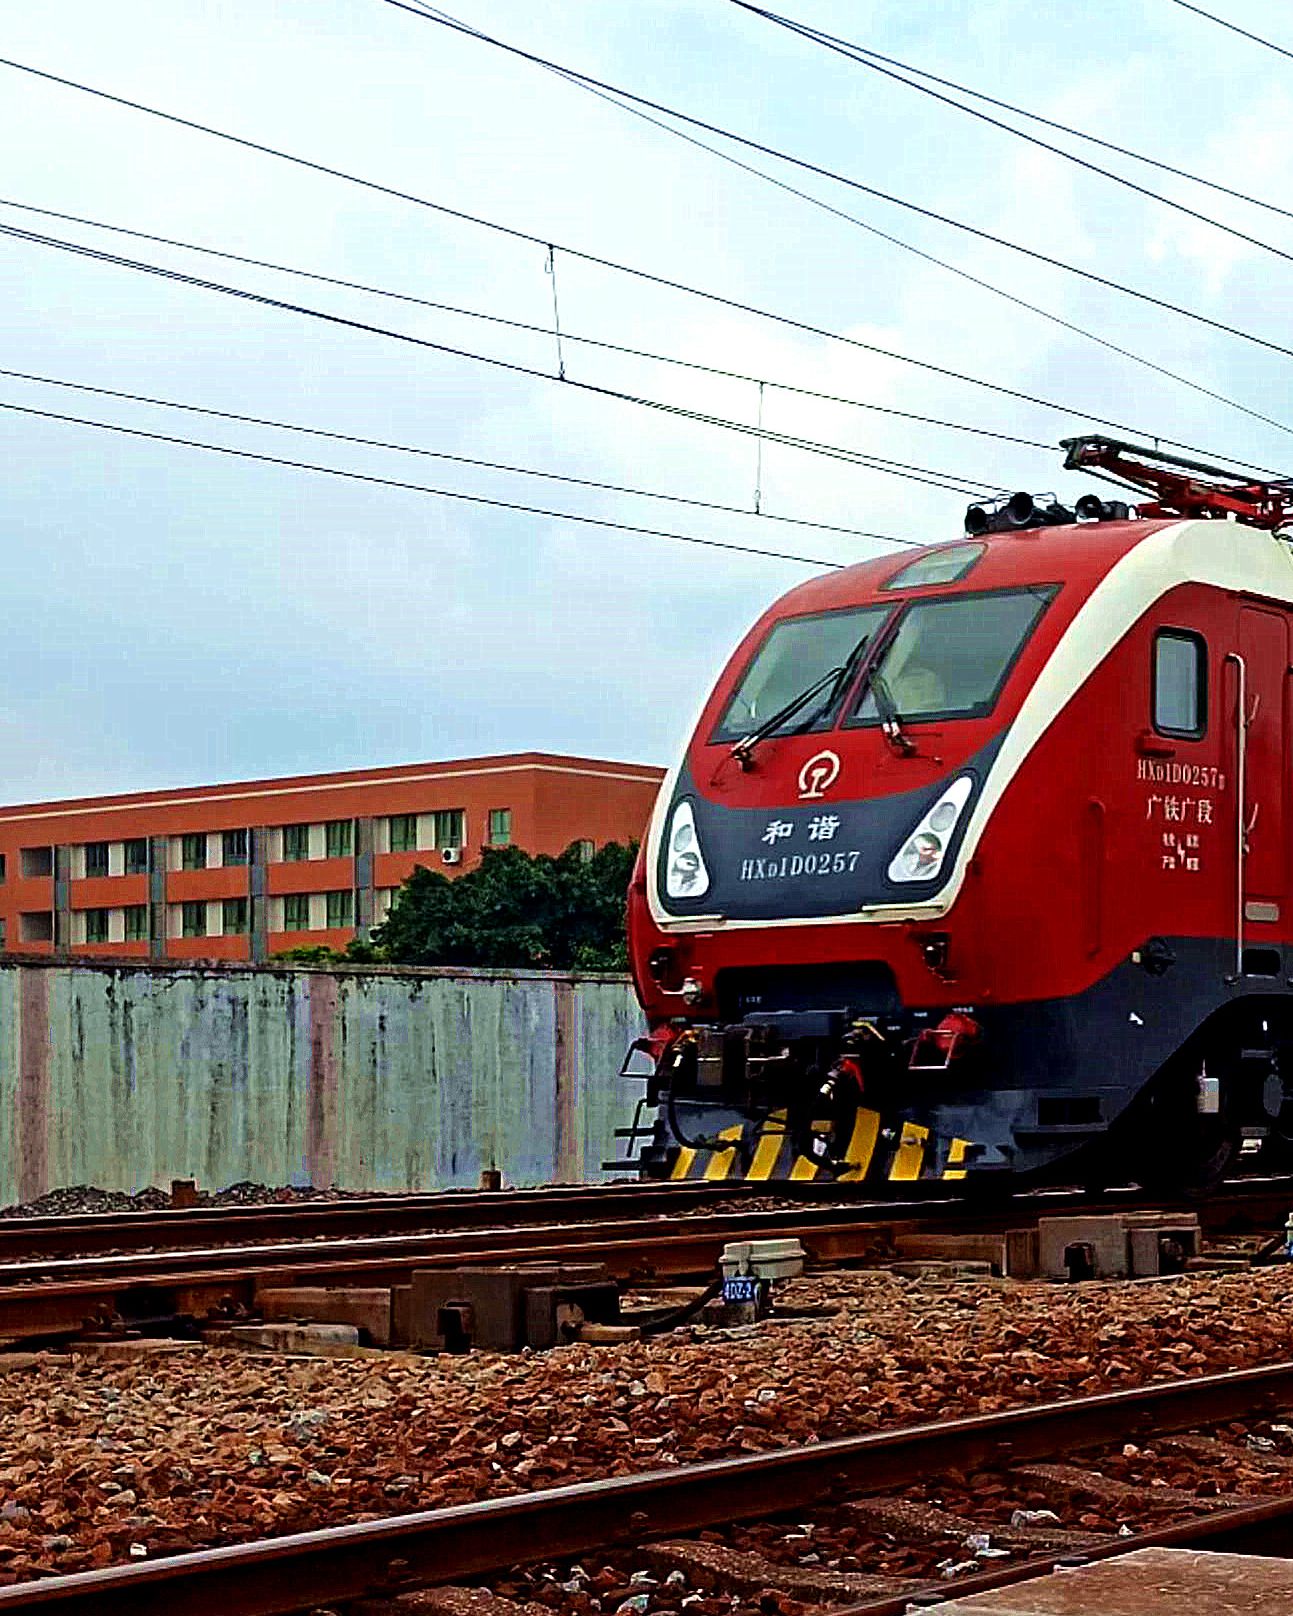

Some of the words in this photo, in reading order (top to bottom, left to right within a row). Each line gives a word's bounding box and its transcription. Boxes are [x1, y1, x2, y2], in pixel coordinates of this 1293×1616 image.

[1146, 794, 1213, 824] 广铁广段
[761, 814, 841, 846] 和谐
